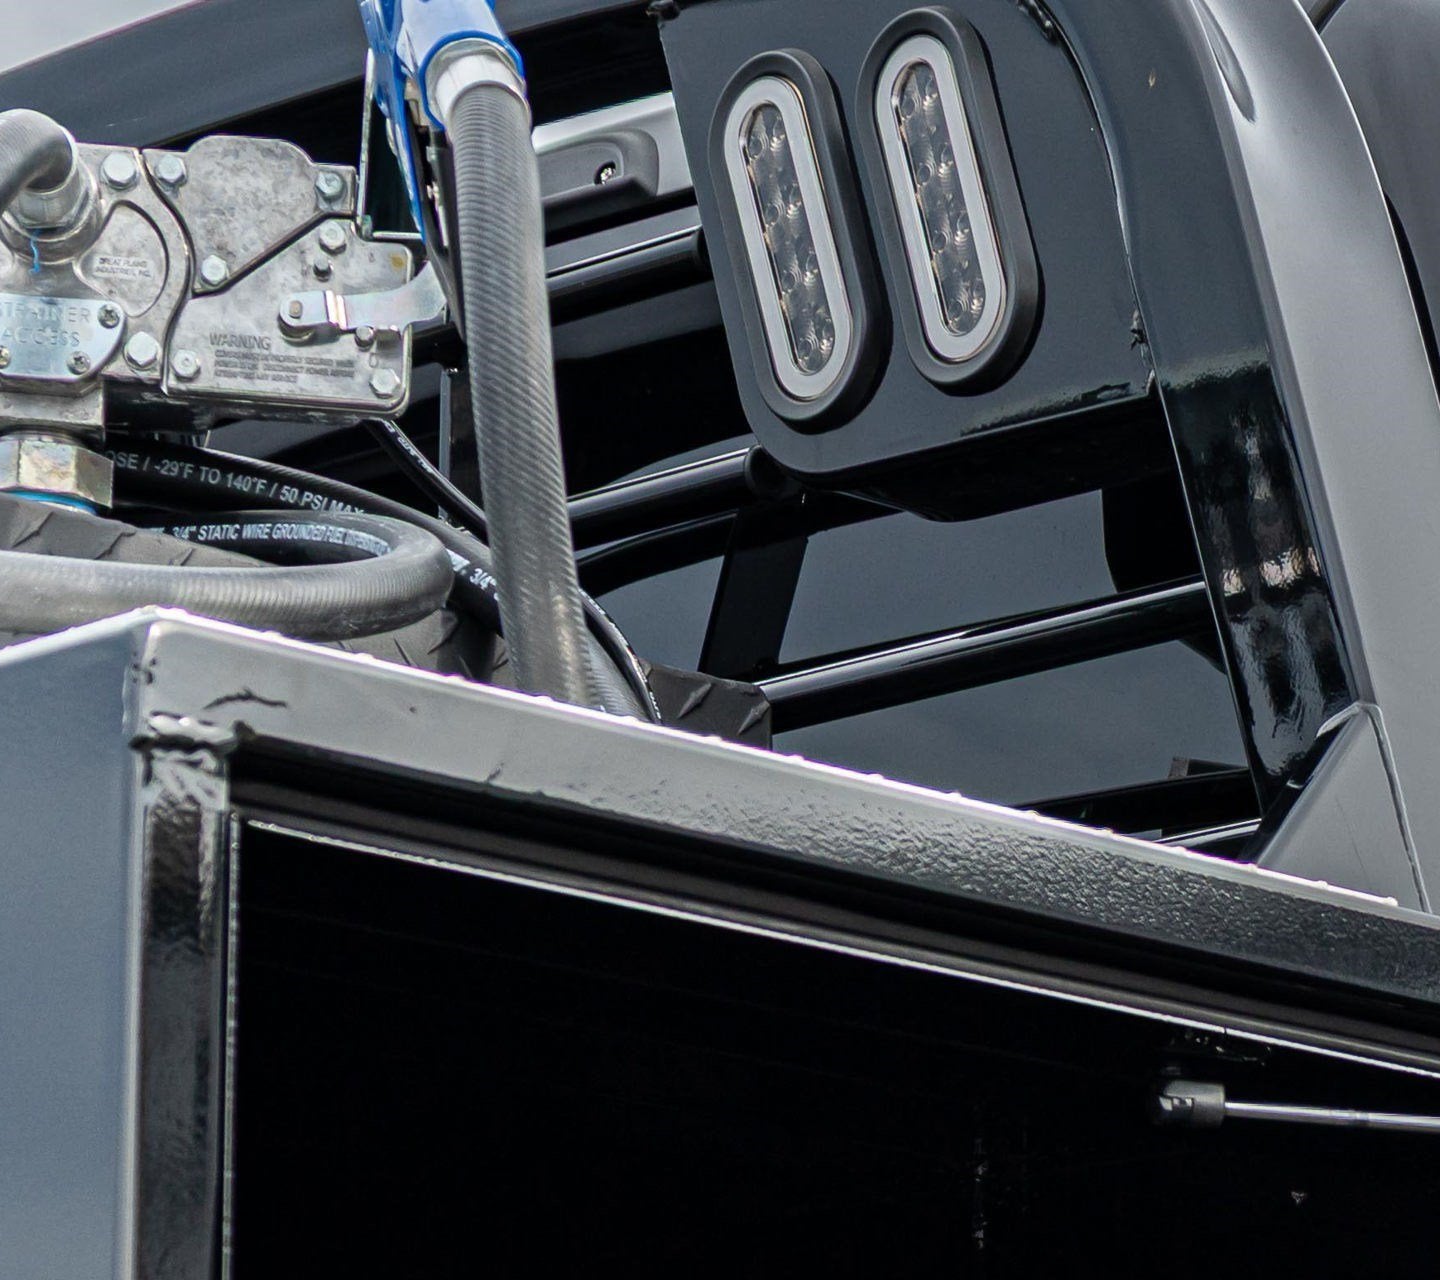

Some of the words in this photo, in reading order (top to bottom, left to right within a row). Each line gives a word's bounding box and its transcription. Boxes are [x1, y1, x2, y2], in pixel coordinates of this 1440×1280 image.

[1, 327, 81, 348] ACCESS
[210, 333, 273, 350] WARNING
[105, 450, 138, 470] OSE
[200, 466, 221, 485] TO
[279, 485, 299, 503] 50
[300, 491, 328, 512] PSI
[198, 524, 240, 540] STATIC
[242, 522, 270, 539] WIRE
[272, 521, 326, 542] GROUNDED
